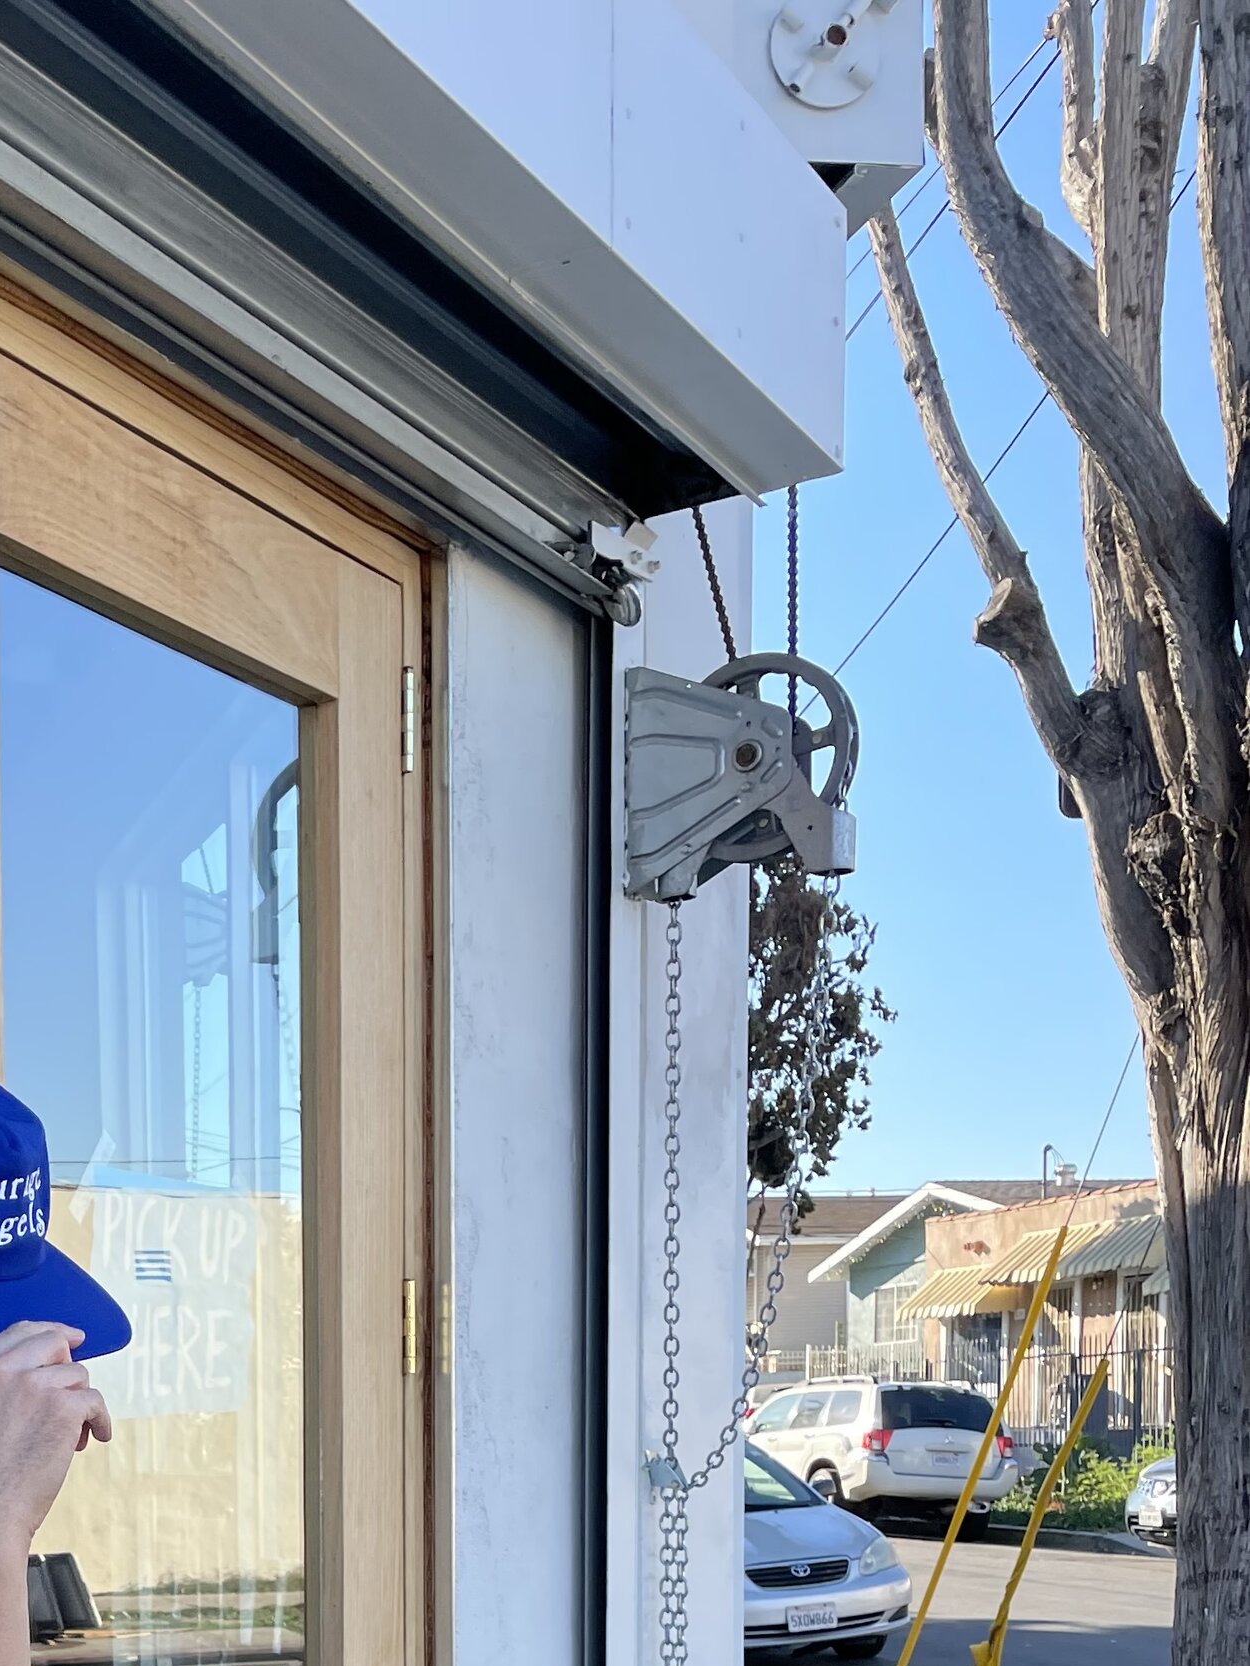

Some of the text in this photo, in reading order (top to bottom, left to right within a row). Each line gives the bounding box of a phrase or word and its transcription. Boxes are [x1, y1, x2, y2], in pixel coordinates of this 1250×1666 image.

[103, 1188, 247, 1285] PICK UP
[126, 1303, 234, 1405] HERE
